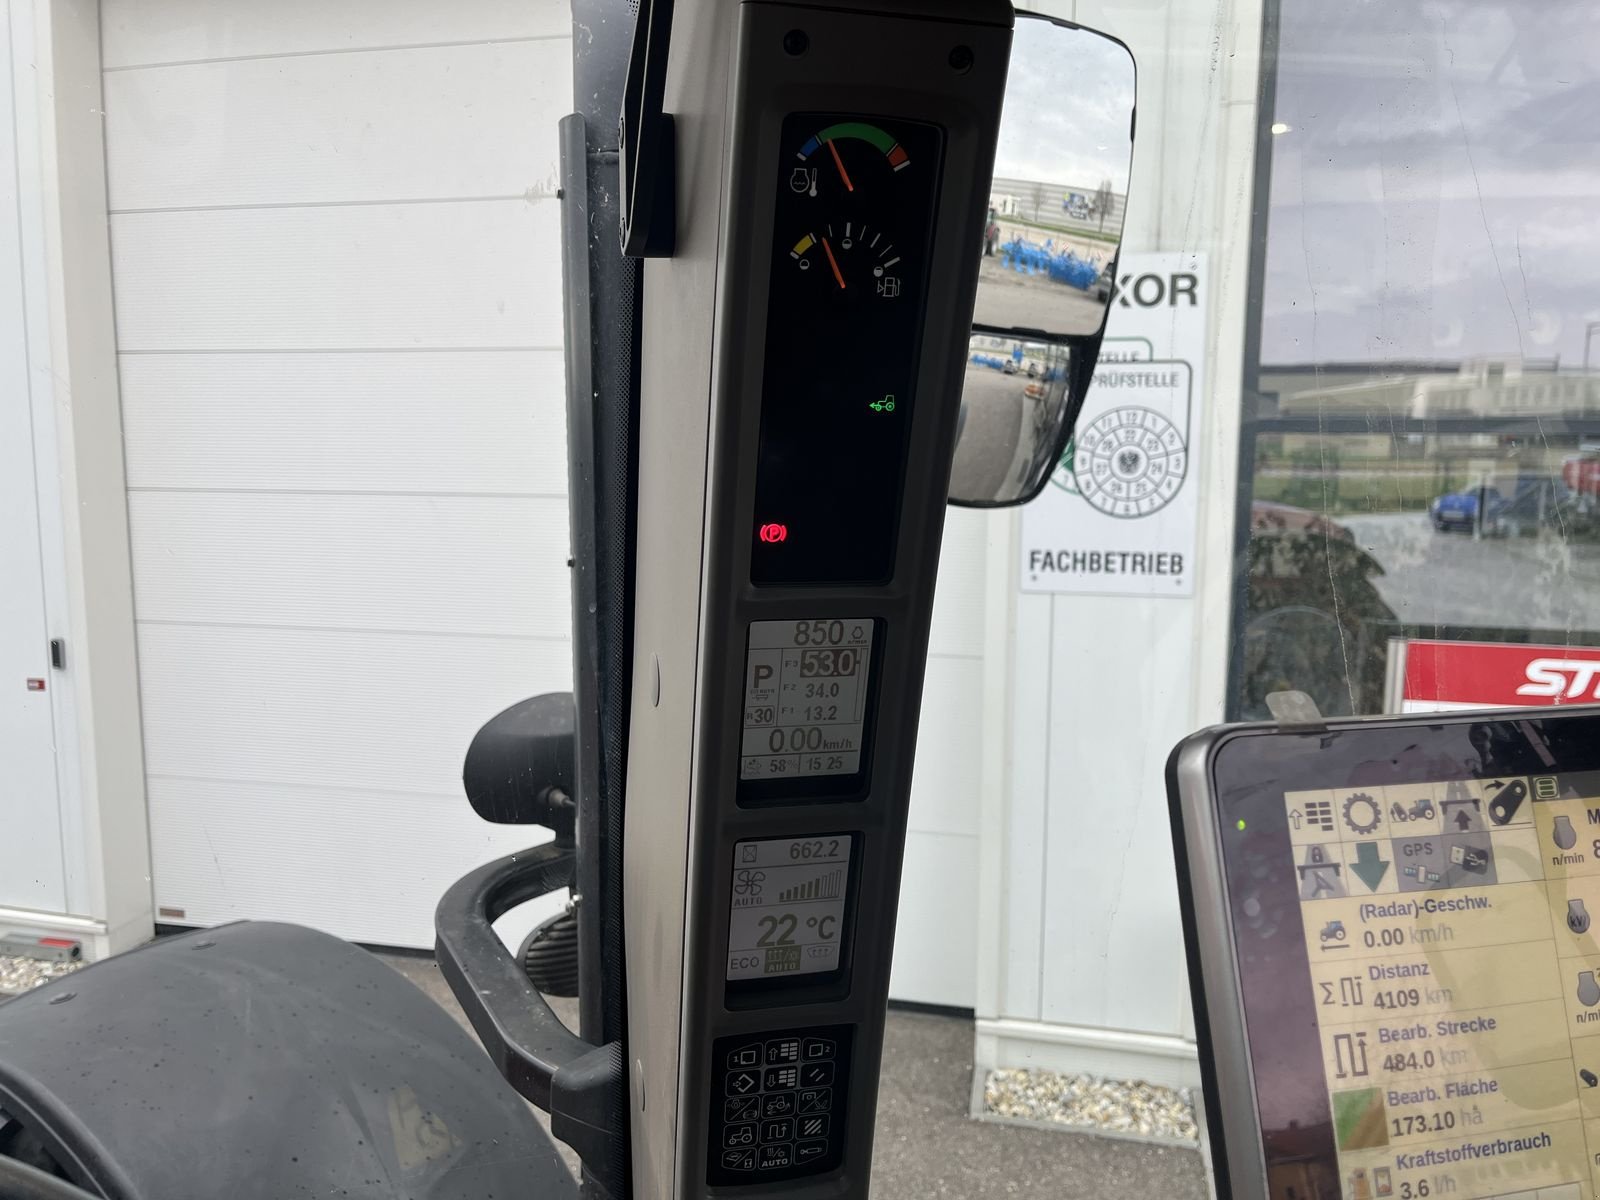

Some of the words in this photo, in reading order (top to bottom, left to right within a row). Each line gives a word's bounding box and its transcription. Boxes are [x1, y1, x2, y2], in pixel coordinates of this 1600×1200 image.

[1029, 549, 1184, 576] FACHBETRIEB
[794, 620, 845, 646] 850
[802, 650, 855, 676] 53.0
[753, 664, 774, 689] P
[805, 682, 840, 698] 34.0
[804, 705, 838, 721] 13.2
[790, 840, 840, 860] 662.2
[1402, 842, 1434, 857] GPS
[1552, 851, 1585, 866] n/min
[734, 896, 763, 907] AUTO
[1359, 895, 1493, 924] (Radar)-Geschw.
[756, 913, 798, 948] 22
[806, 914, 836, 940] °C
[1363, 928, 1405, 949] 0.00
[1409, 923, 1454, 945] km/h
[730, 956, 760, 970] ECO
[768, 961, 796, 973] AUTO
[1369, 962, 1430, 982] Distanz
[1373, 989, 1420, 1010] 4109
[1425, 986, 1453, 1004] km
[1378, 1023, 1432, 1044] Bearb.
[1437, 1016, 1497, 1036] Strecke
[1383, 1050, 1435, 1072] 484.0
[1388, 1086, 1441, 1107] Bearb.
[1445, 1078, 1498, 1099] Fläche
[1391, 1111, 1455, 1137] 173.10
[1396, 1132, 1552, 1170] Kraftstoffverbrauch
[761, 1158, 788, 1168] AUTO
[1400, 1178, 1430, 1200] 3.6
